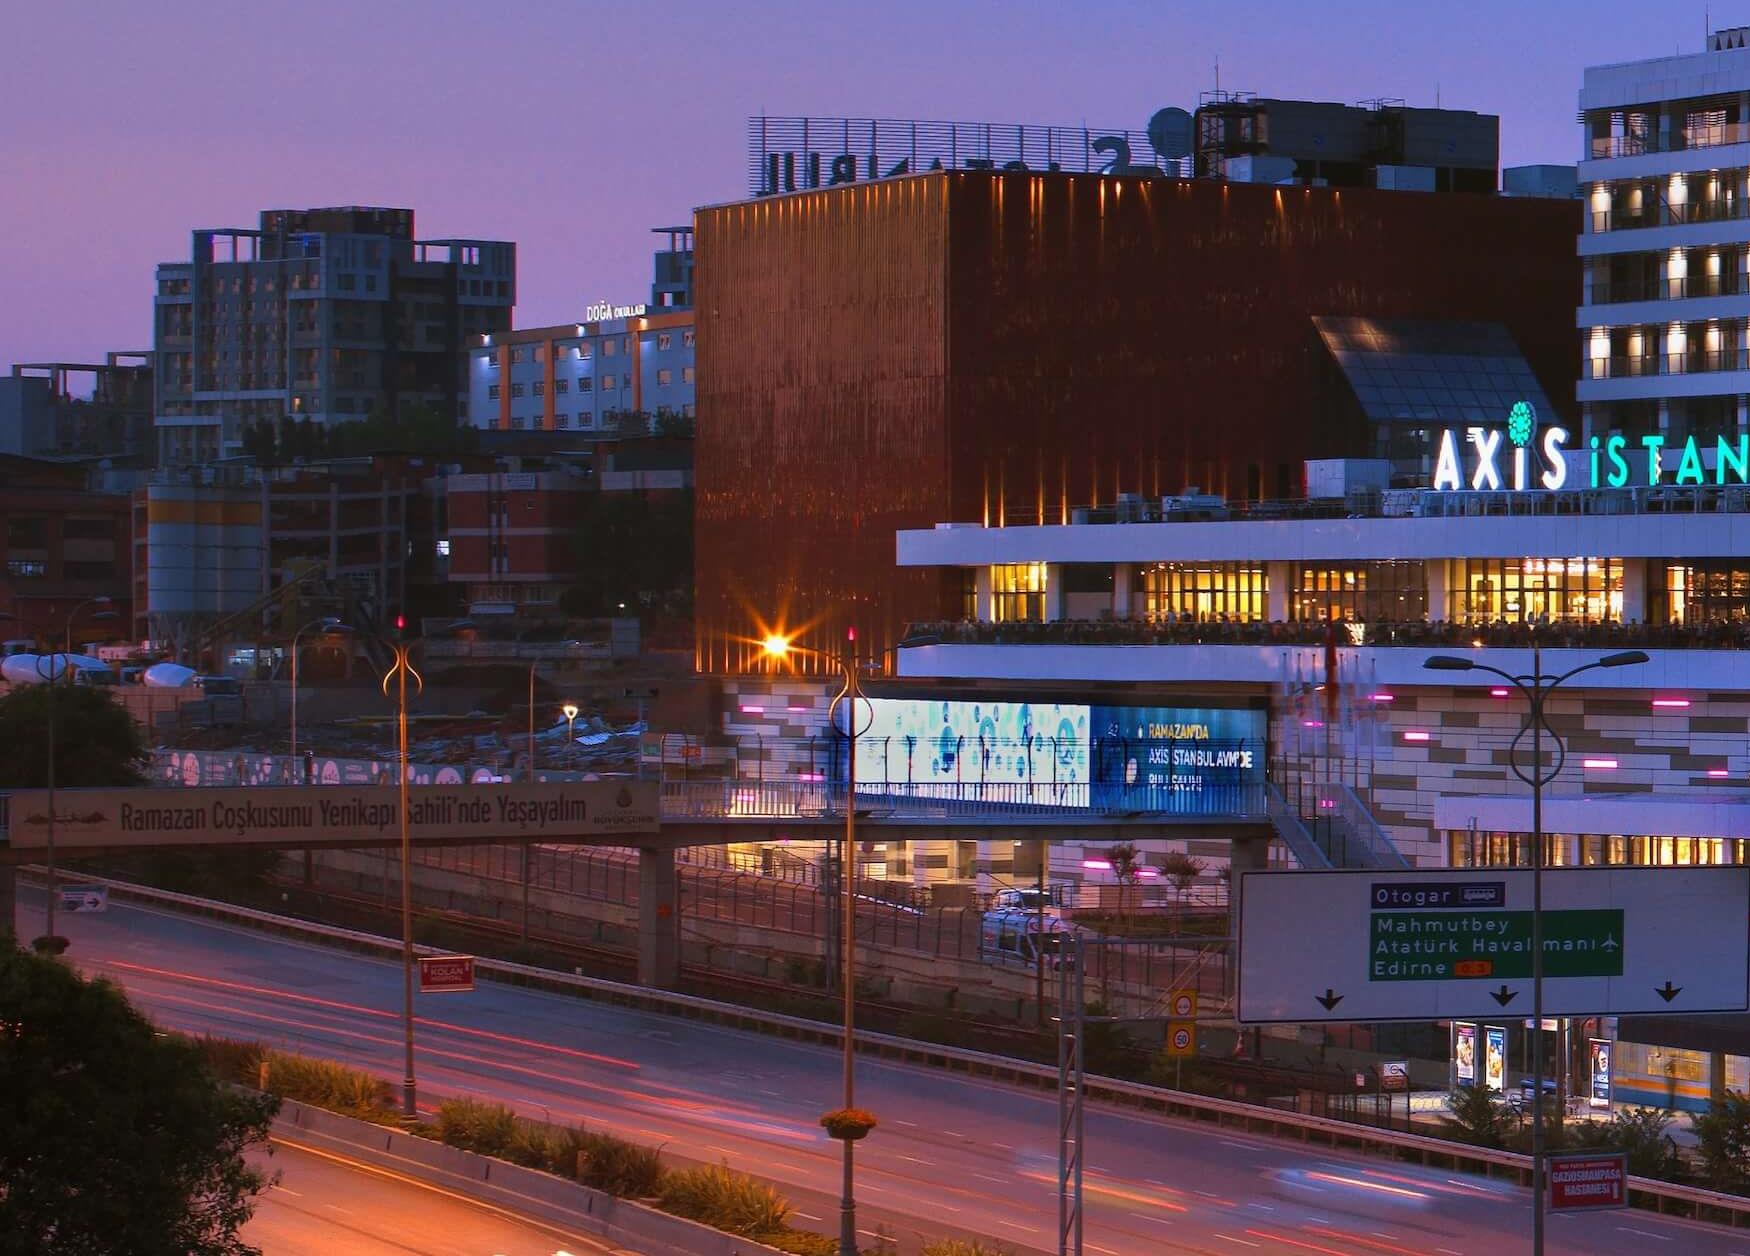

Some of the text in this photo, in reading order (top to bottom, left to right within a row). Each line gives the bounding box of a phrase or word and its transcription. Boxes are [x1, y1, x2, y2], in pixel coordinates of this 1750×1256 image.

[587, 300, 612, 320] DOĞA
[121, 803, 206, 830] Ramazan
[213, 800, 312, 835] Coşkusunu
[320, 798, 396, 832] Yenikapı
[499, 794, 587, 829] Yaşayalım
[1376, 889, 1451, 906] Otogar
[1377, 917, 1509, 934] Mahmutbey
[1375, 938, 1596, 954] Atatürk Havalmanı
[1374, 961, 1446, 976] Edirne
